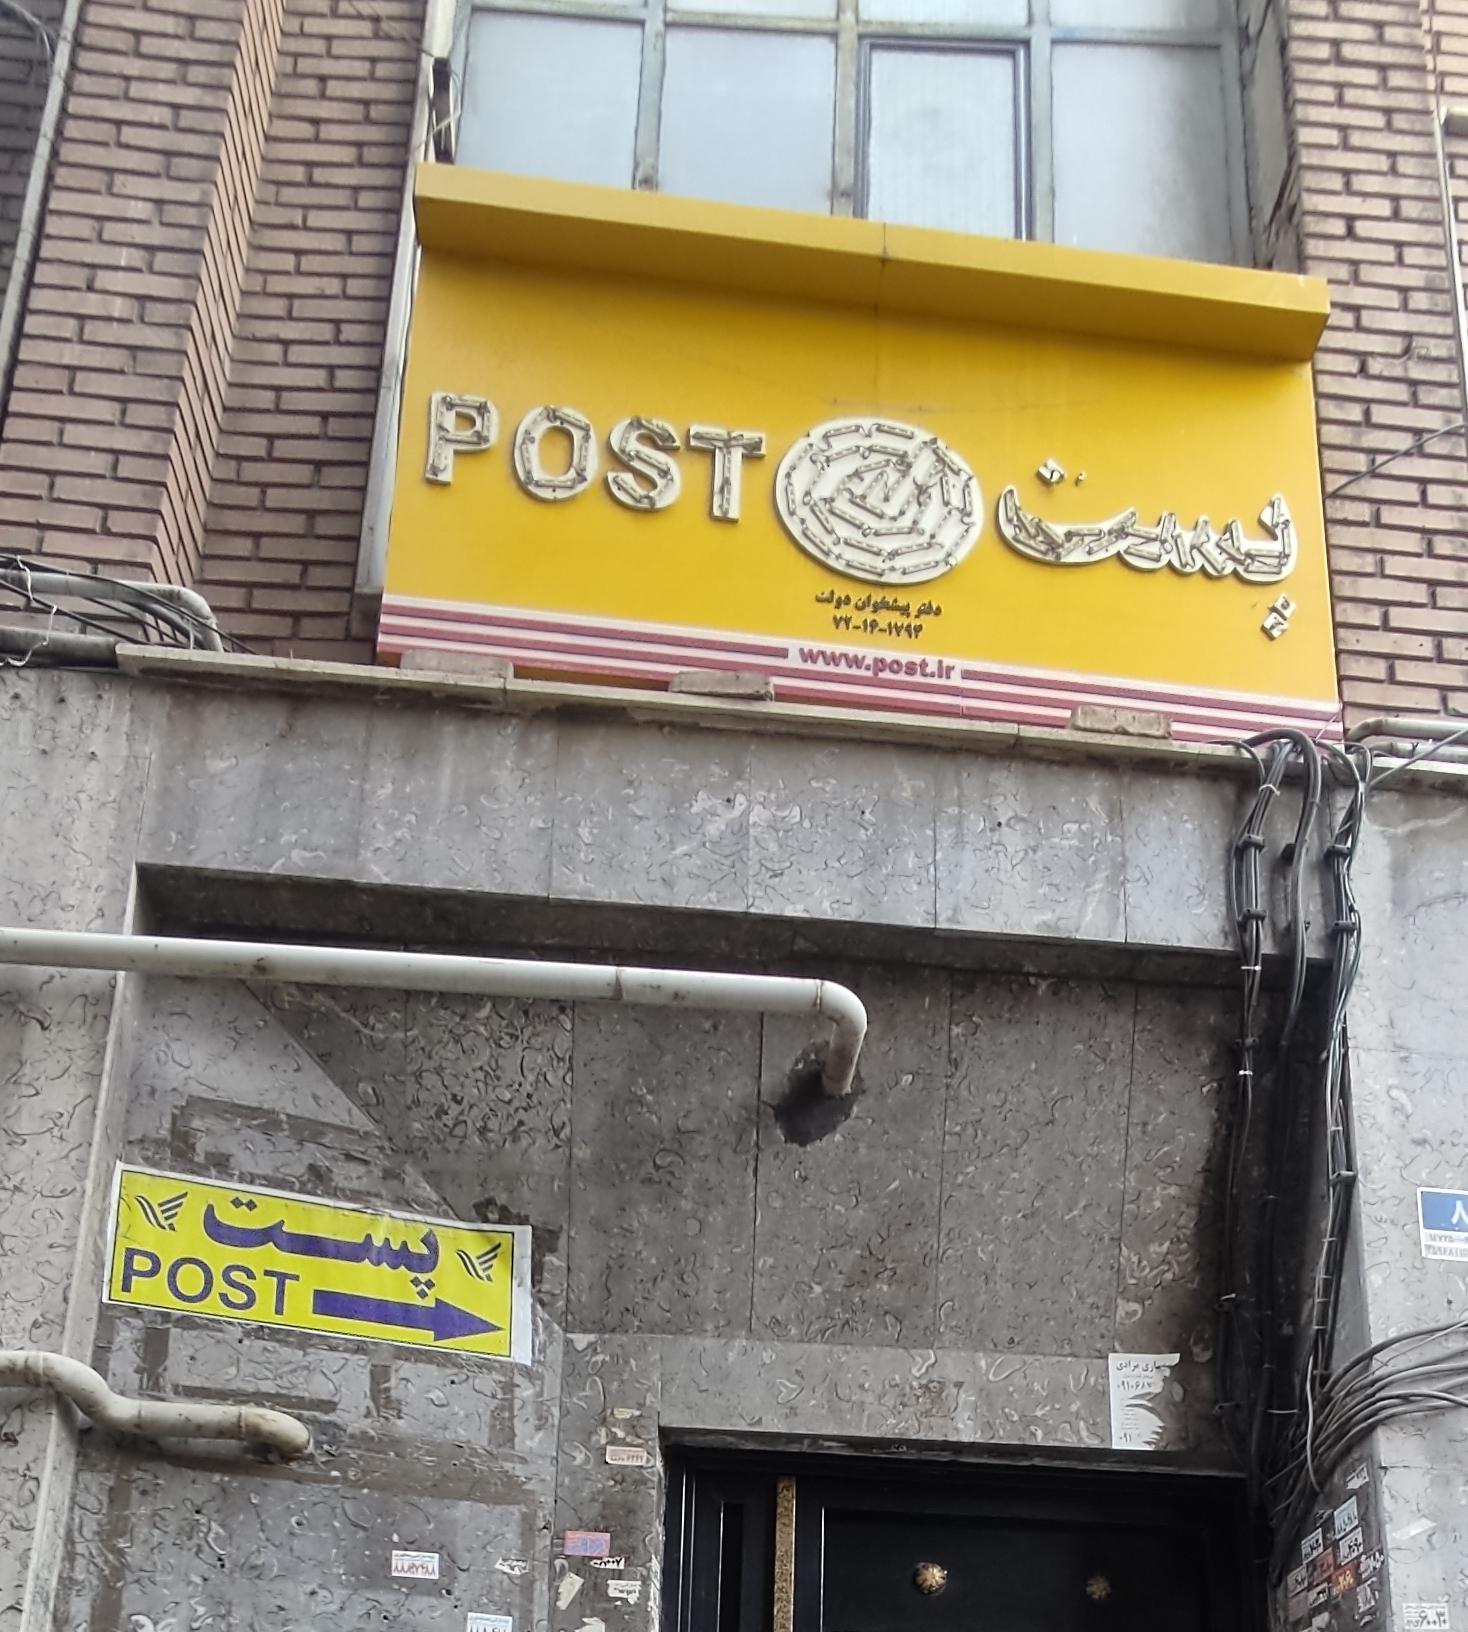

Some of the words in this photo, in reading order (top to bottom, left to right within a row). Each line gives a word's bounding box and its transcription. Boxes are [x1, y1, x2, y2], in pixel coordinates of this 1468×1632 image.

[424, 391, 767, 523] POST
[997, 457, 1298, 641] پست
[814, 589, 852, 610] دولت
[914, 600, 942, 619] دفتر
[798, 647, 956, 680] www.post.ir
[120, 1247, 300, 1316] POST
[203, 1195, 440, 1300] پست
